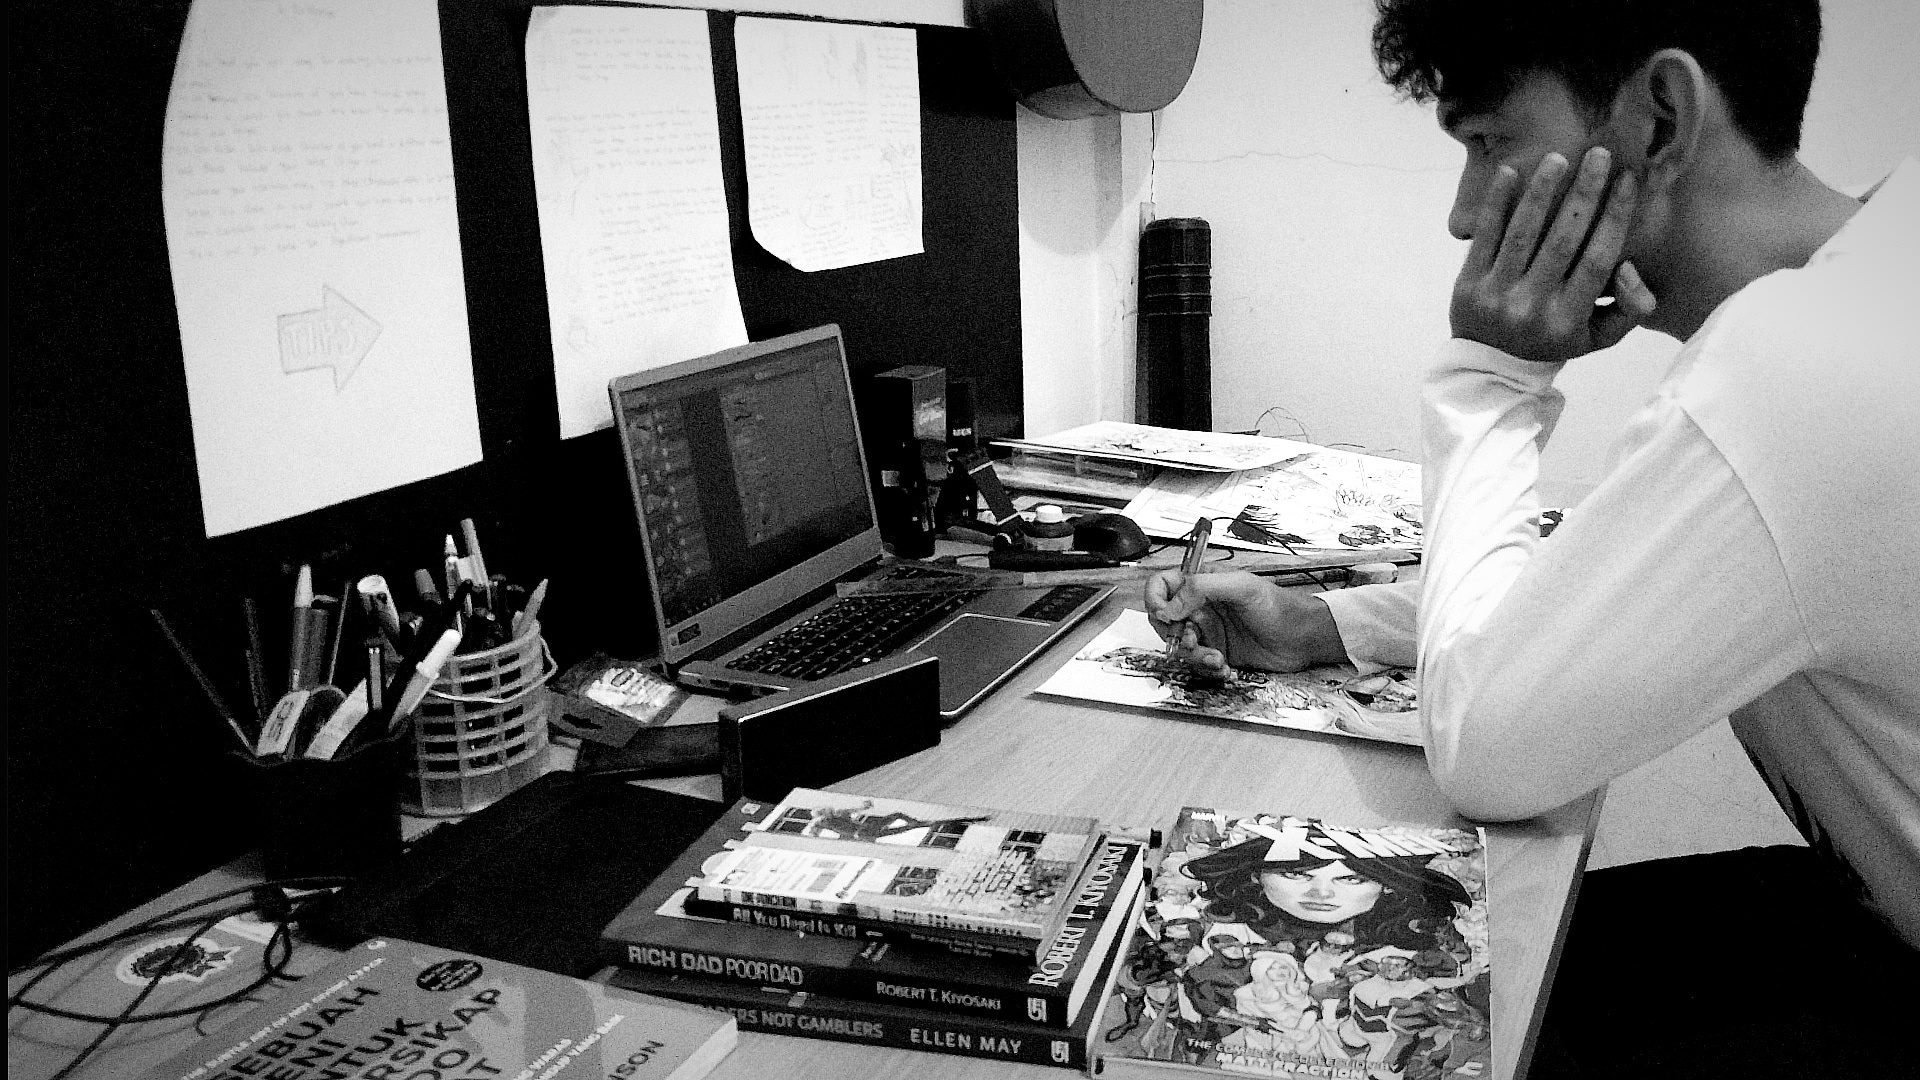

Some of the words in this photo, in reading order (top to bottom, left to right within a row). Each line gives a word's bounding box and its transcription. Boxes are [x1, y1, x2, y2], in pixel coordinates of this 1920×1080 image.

[1028, 926, 1086, 988] ROBERT
[1078, 846, 1129, 907] KIYOSAKI
[628, 945, 677, 969] RICH
[680, 953, 723, 974] DAD
[725, 957, 768, 981] POOR
[769, 963, 804, 986] DAD
[875, 980, 927, 1000] ROBERT
[929, 987, 939, 1002] T.
[941, 989, 1002, 1011] KIYOSAKI
[762, 1010, 796, 1029] NOT
[797, 1014, 884, 1039] GAMBLERS
[909, 1027, 972, 1050] ELLEN
[979, 1035, 1023, 1055] MAY
[1215, 1052, 1269, 1068] MATT
[1272, 1059, 1366, 1079] FRACTION
